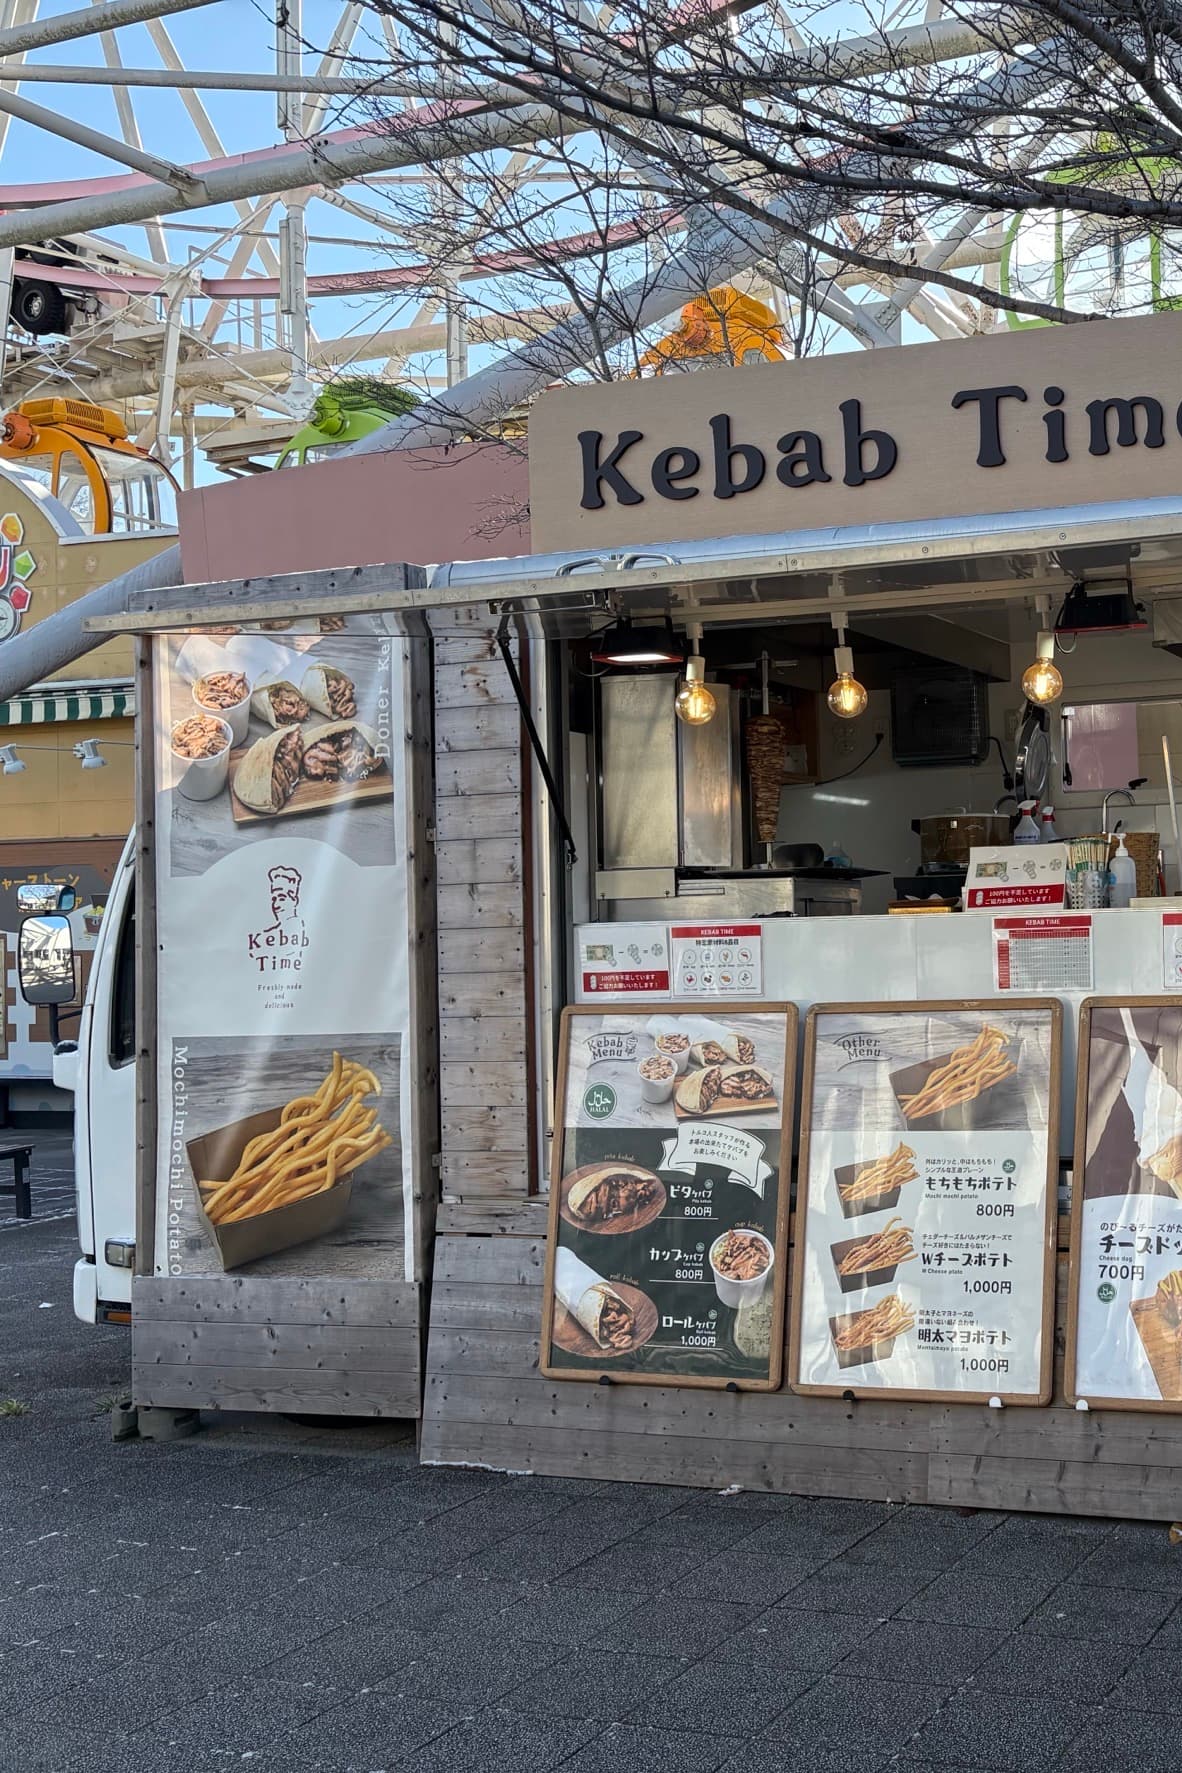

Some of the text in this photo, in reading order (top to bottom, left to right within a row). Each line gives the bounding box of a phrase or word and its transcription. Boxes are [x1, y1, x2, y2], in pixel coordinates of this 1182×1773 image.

[577, 399, 898, 510] Kebab
[375, 686, 391, 759] Doner
[248, 930, 310, 950] Kebab
[256, 955, 302, 971] Time
[587, 1036, 623, 1051] Kebab
[842, 1036, 881, 1051] Other
[592, 1048, 623, 1060] Menu
[848, 1048, 881, 1060] Menu
[168, 1046, 188, 1277] Mochimochi Potato
[925, 1176, 1017, 1191] もちもちポテト
[684, 1206, 712, 1217] 800円
[976, 1204, 1015, 1218] 800円
[922, 1252, 1013, 1267] Wチーズポテト
[675, 1269, 703, 1280] 800円
[1098, 1264, 1144, 1280] 700円
[963, 1280, 1012, 1295] 1,000円
[662, 1316, 716, 1330] ロールケバブ
[681, 1336, 716, 1347] 1,000円
[918, 1328, 1012, 1345] 明太マヨポテト
[960, 1358, 1009, 1373] 1,000円
